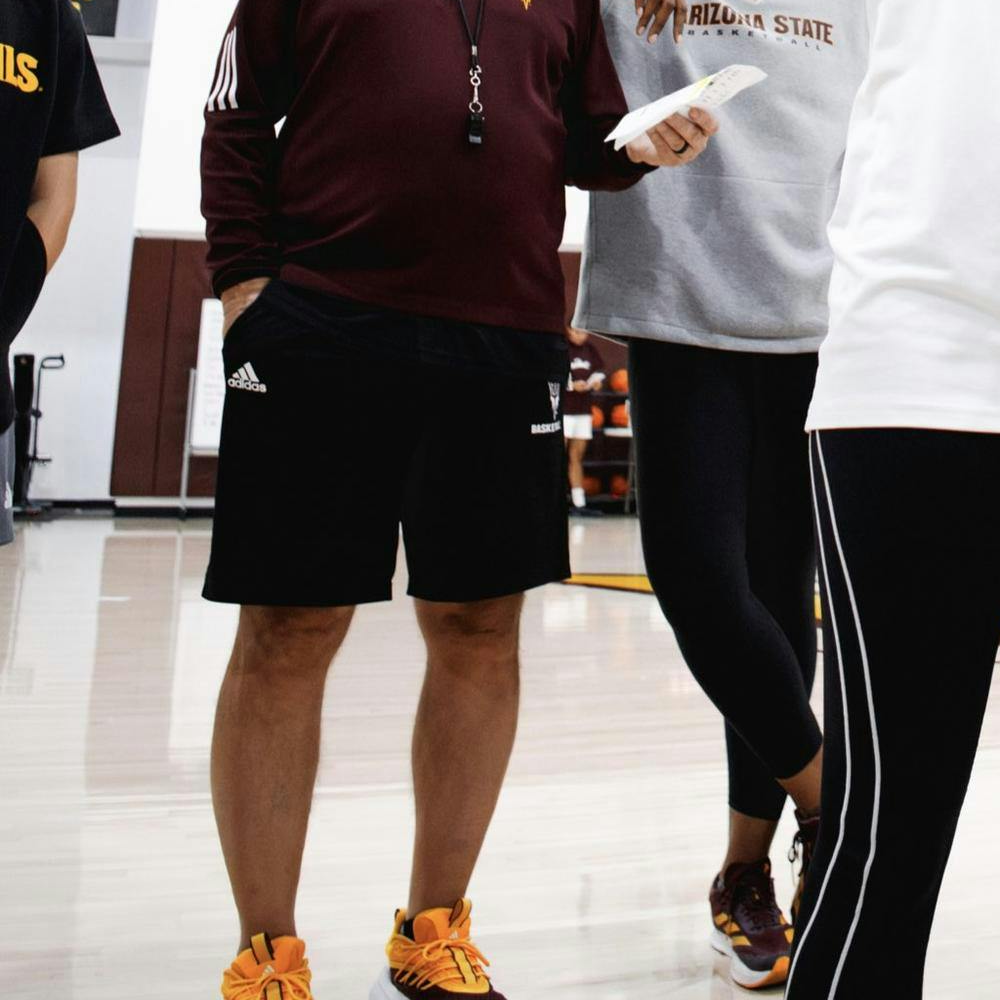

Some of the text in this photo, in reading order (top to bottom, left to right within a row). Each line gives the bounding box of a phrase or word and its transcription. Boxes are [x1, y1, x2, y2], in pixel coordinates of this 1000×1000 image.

[685, 2, 834, 46] RIZONA STATE
[227, 377, 267, 393] adidas
